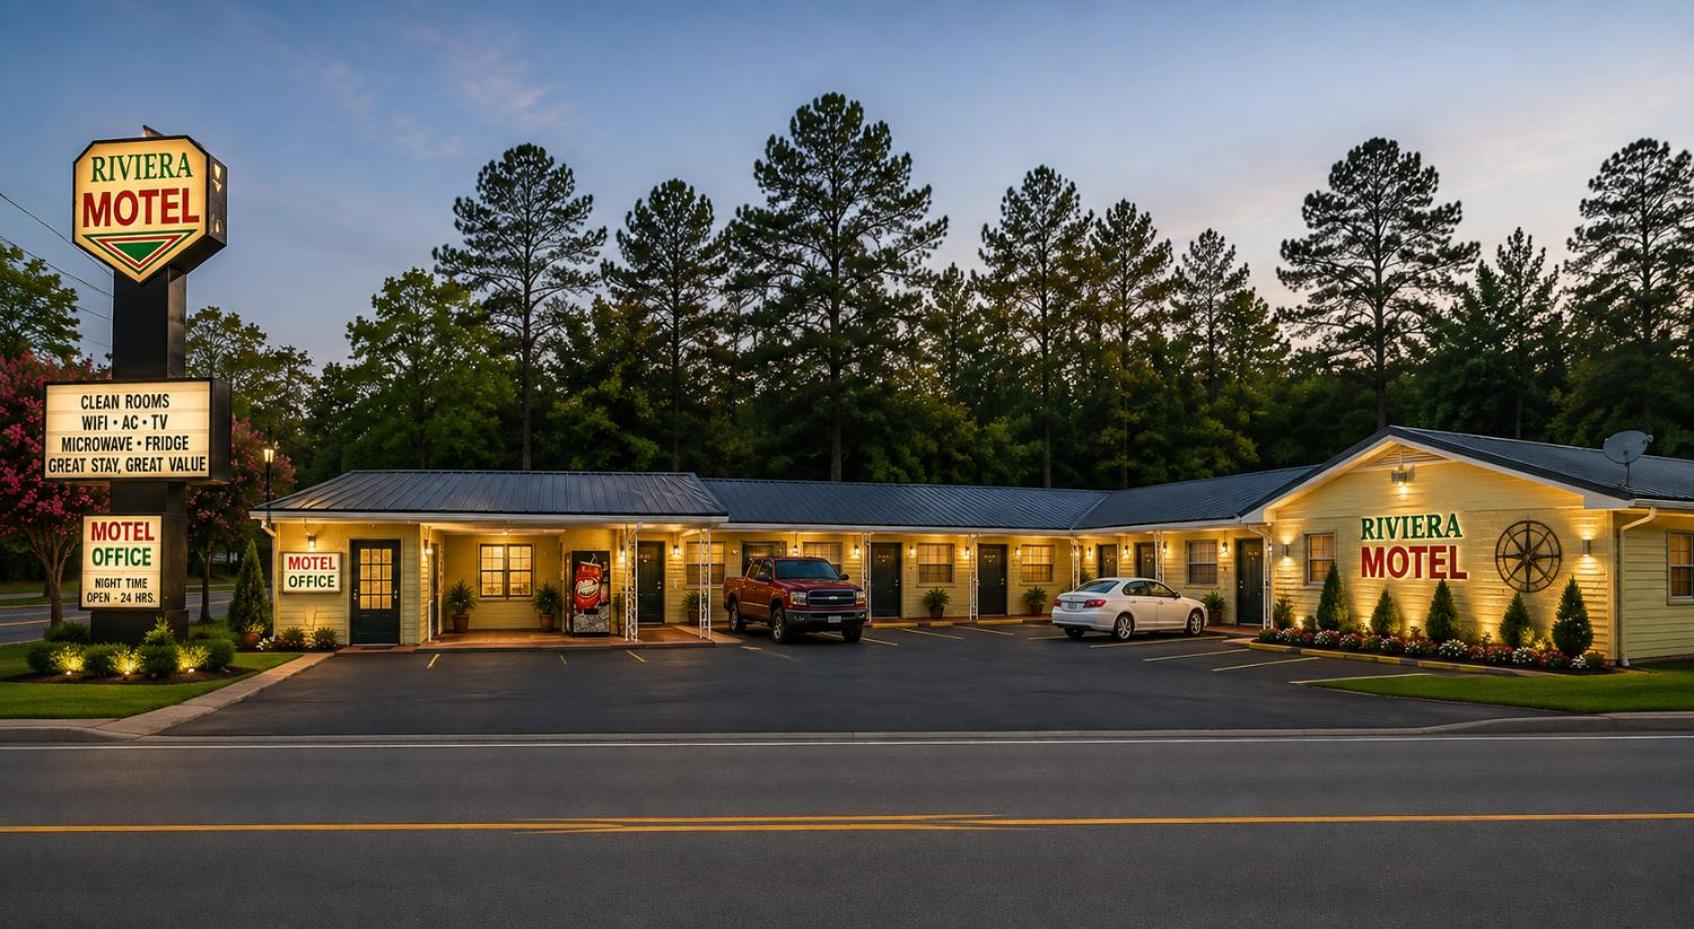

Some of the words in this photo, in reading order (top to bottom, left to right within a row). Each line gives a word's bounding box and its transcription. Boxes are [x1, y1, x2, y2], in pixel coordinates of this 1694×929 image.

[91, 152, 193, 182] RIVIERA
[83, 188, 200, 227] MOTEL
[81, 395, 119, 409] CLEAN
[125, 394, 170, 409] ROOMS
[82, 415, 108, 430] WIFI
[122, 415, 139, 430] AC
[151, 414, 168, 430] TV
[61, 436, 133, 452] MICROWAVE
[145, 435, 189, 451] FRIDGE
[48, 458, 86, 473] GREAT
[91, 457, 121, 474] STAY,
[126, 457, 163, 473] GREAT
[169, 456, 206, 472] VALUE
[91, 521, 155, 541] MOTEL
[1361, 513, 1462, 540] RIVIERA
[92, 547, 151, 567] OFFICE
[288, 556, 336, 570] MOTEL
[1361, 545, 1468, 579] MOTEL
[95, 578, 122, 588] NIGHT
[126, 578, 148, 588] TIME
[288, 575, 335, 588] OFFICE
[87, 592, 110, 603] OPEN
[120, 592, 131, 603] 24
[135, 592, 156, 603] HRS.
